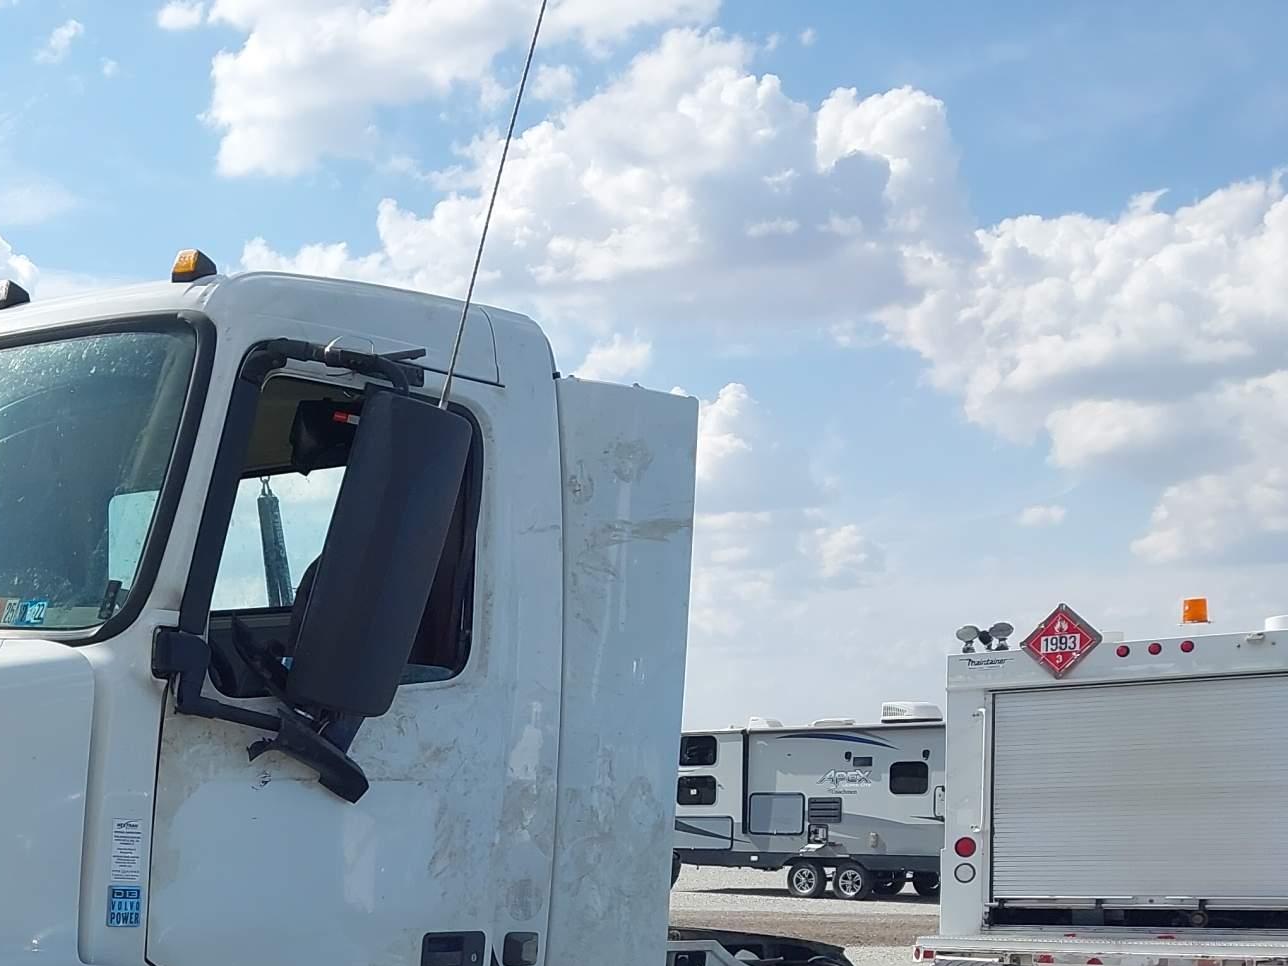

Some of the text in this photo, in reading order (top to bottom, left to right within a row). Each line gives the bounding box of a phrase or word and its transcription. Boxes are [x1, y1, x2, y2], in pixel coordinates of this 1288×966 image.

[1043, 635, 1076, 652] 1993
[1055, 655, 1062, 664] 3
[816, 769, 872, 785] APEX
[112, 900, 140, 911] VOLVO
[110, 911, 140, 925] POWER
